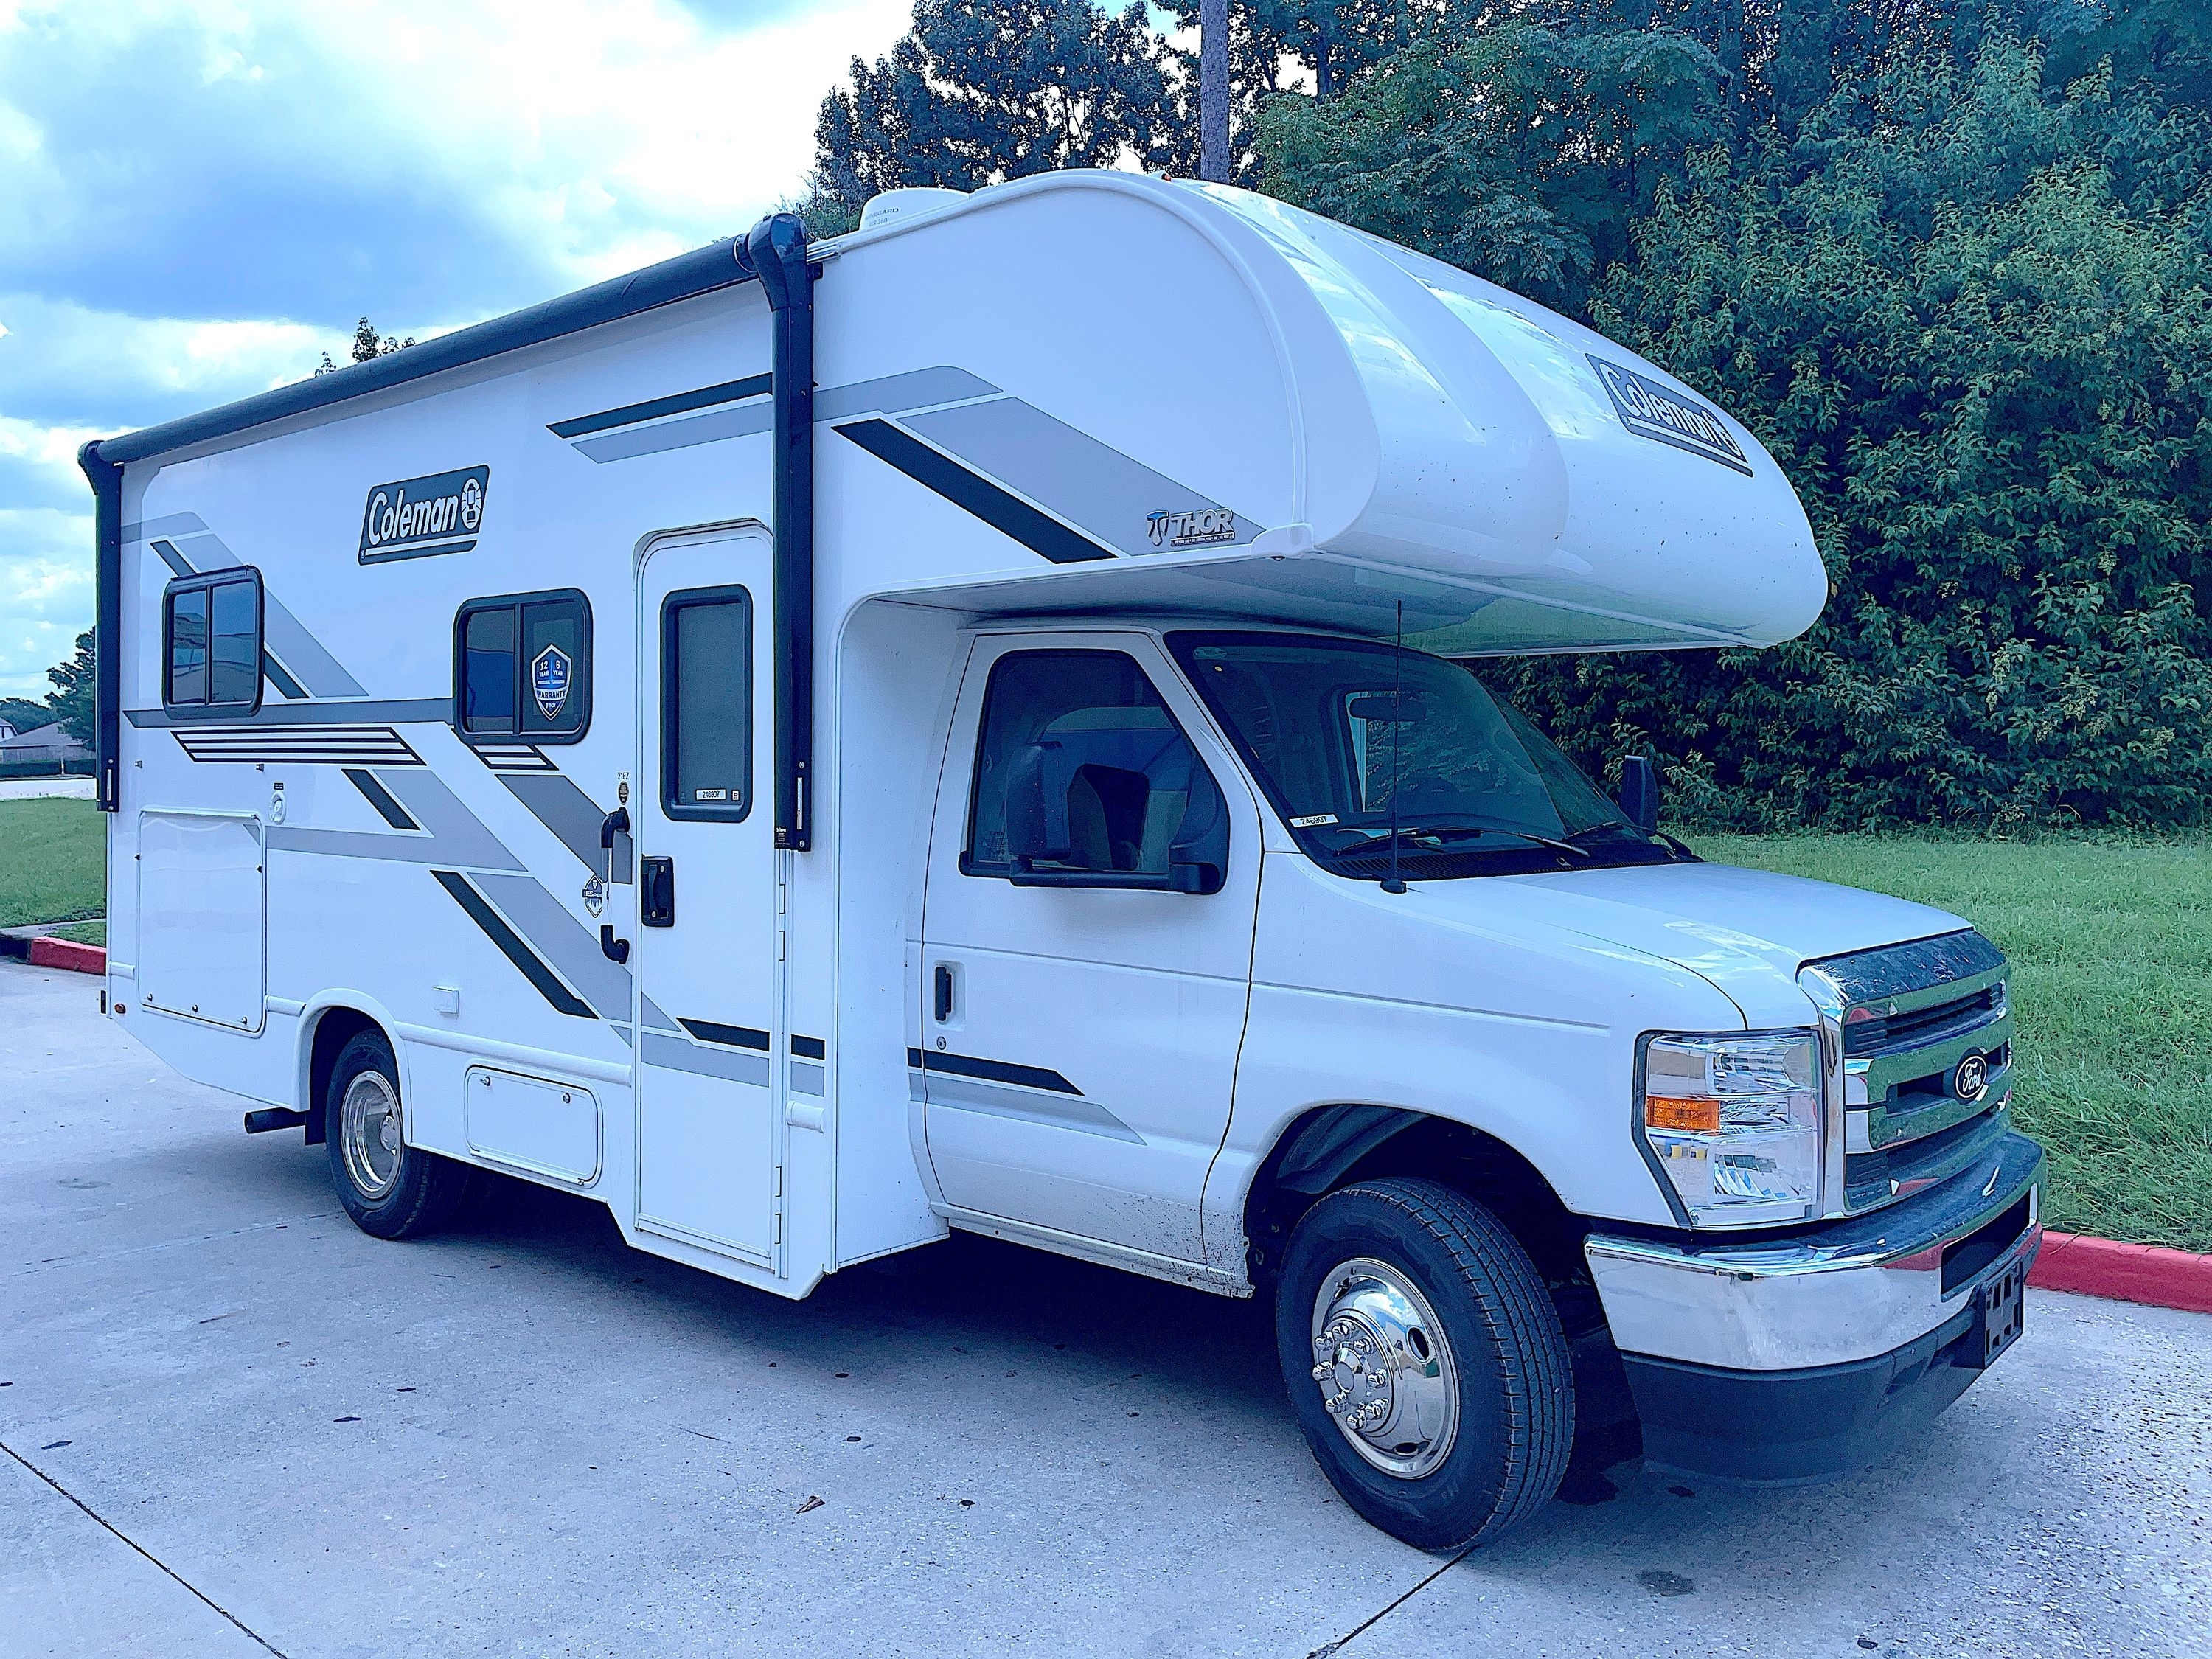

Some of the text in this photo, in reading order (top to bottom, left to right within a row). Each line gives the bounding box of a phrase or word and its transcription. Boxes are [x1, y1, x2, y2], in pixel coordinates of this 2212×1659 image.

[1599, 363, 1723, 448] Coleman
[368, 488, 459, 546] Coleman
[1171, 507, 1235, 539] THOR
[539, 669, 549, 678] YEAR
[540, 660, 549, 671] 12
[555, 659, 560, 669] 6
[536, 689, 566, 699] WARRANTY
[1962, 1062, 1983, 1093] Ford
